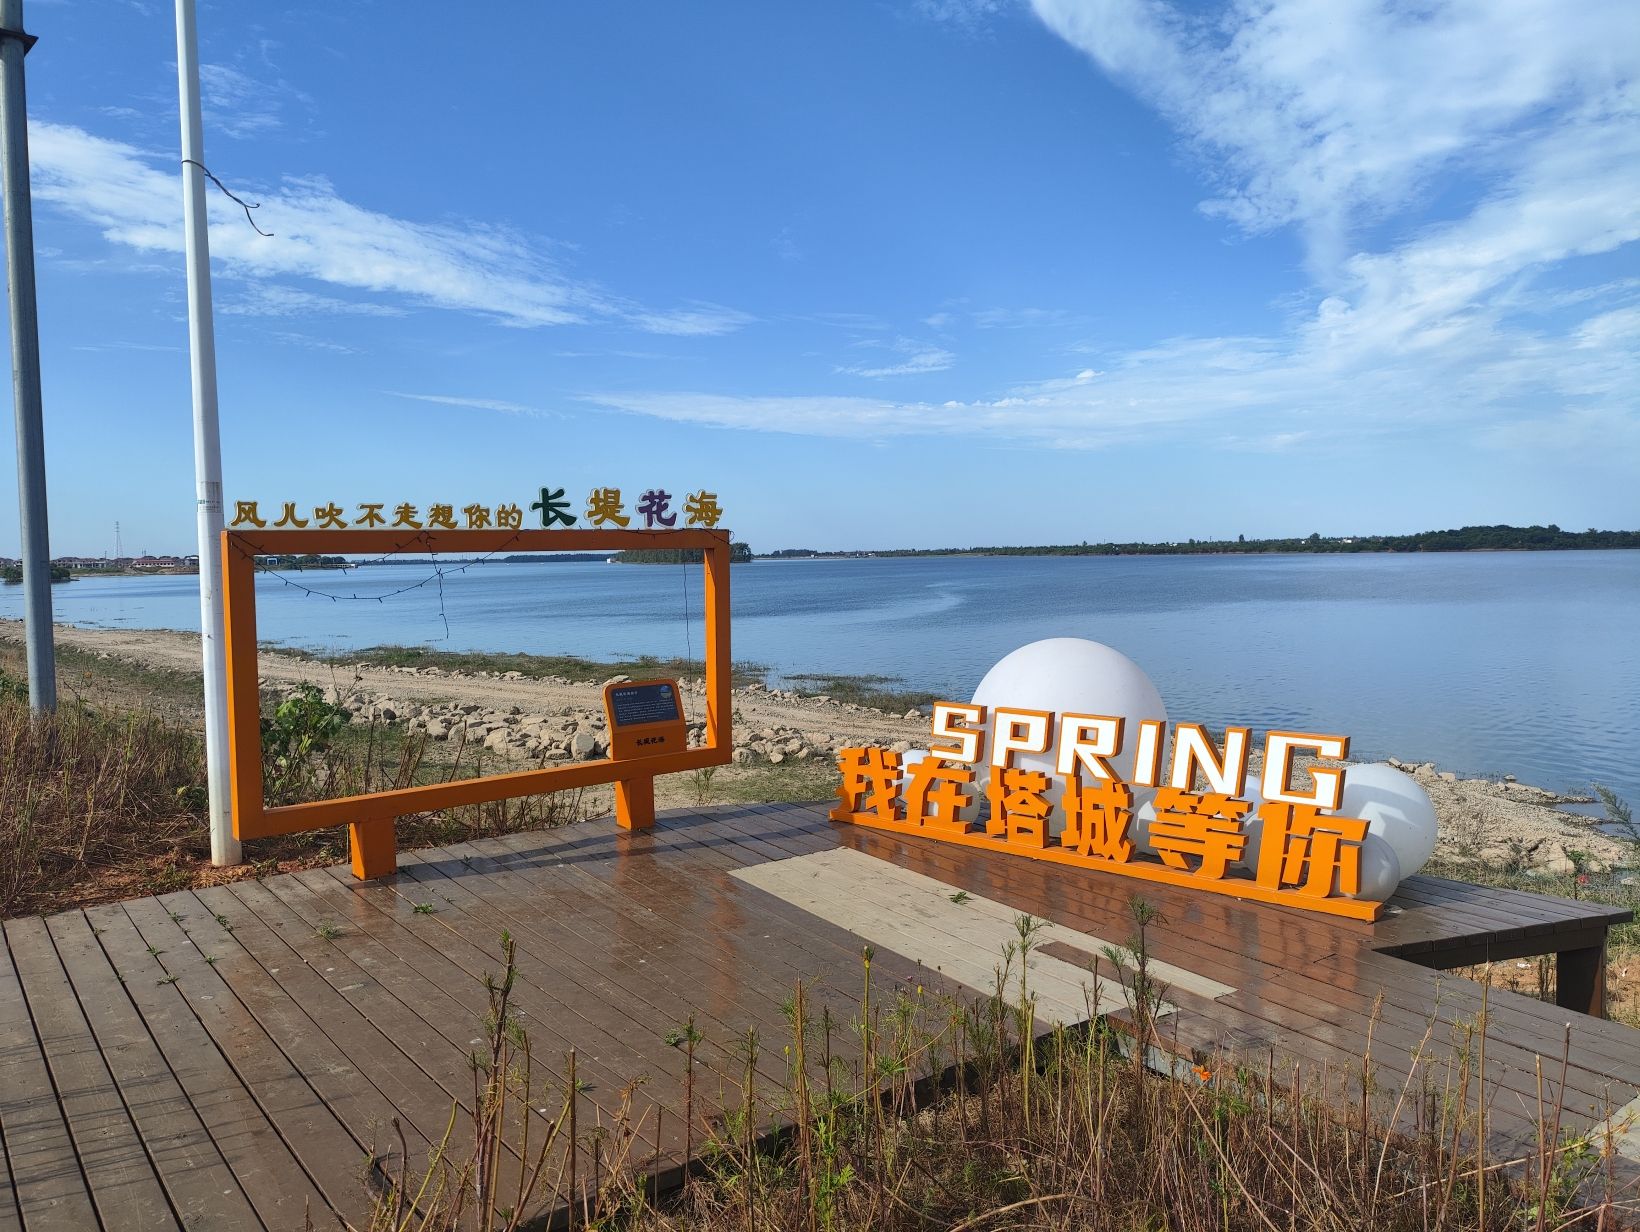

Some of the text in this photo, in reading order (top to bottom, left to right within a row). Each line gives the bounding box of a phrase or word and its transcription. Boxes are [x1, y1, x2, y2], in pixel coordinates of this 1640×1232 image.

[931, 701, 1350, 811] SPRING
[834, 747, 1371, 898] 我在塔城等你
